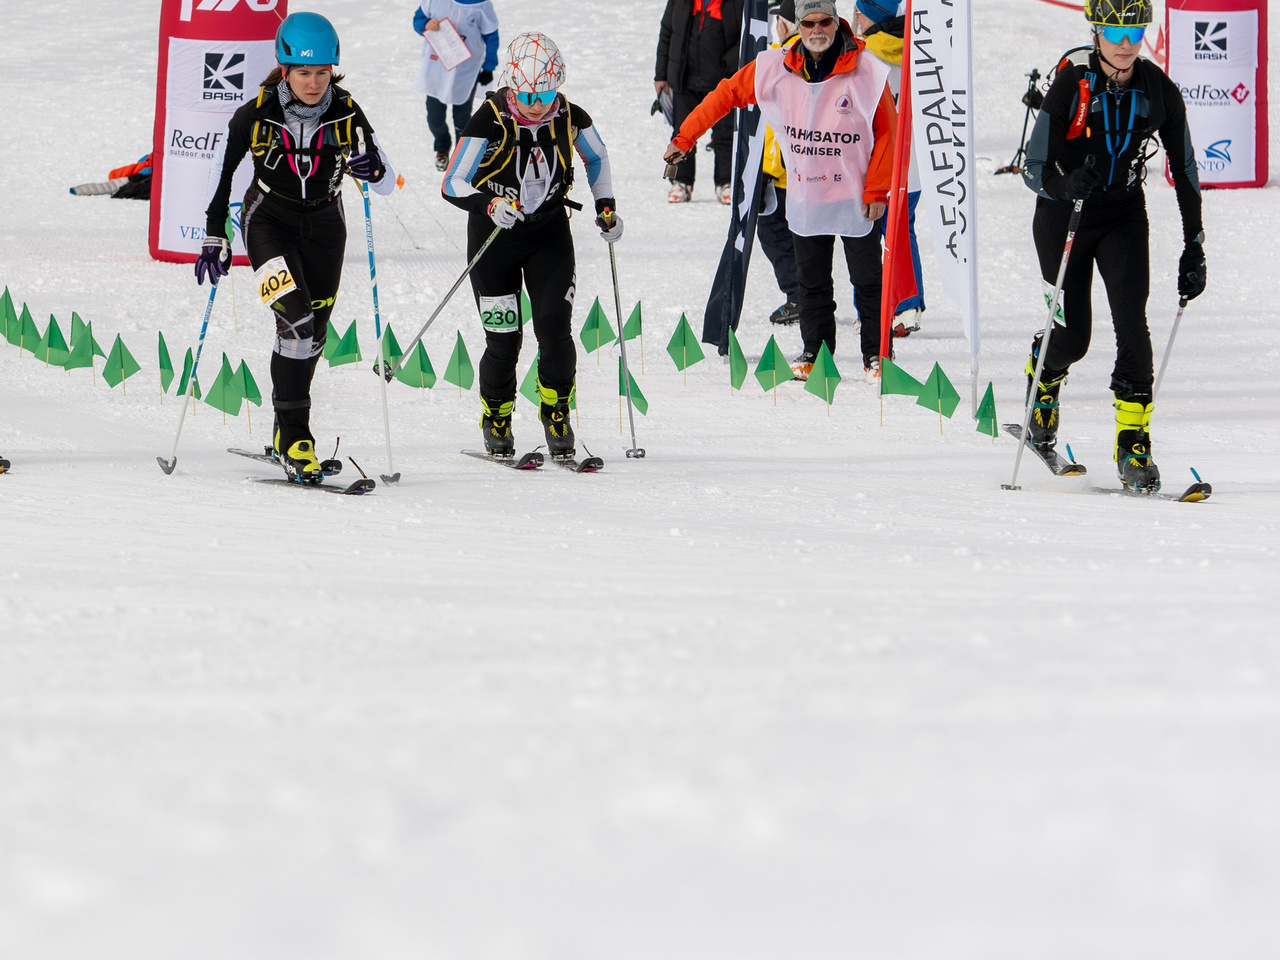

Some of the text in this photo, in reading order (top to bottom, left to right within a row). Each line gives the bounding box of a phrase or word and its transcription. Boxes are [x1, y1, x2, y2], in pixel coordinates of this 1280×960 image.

[202, 91, 244, 101] BASK
[170, 129, 224, 151] RedF
[169, 149, 198, 157] outdoor
[1198, 160, 1226, 172] NTO
[260, 269, 292, 299] 402
[483, 309, 516, 326] 230
